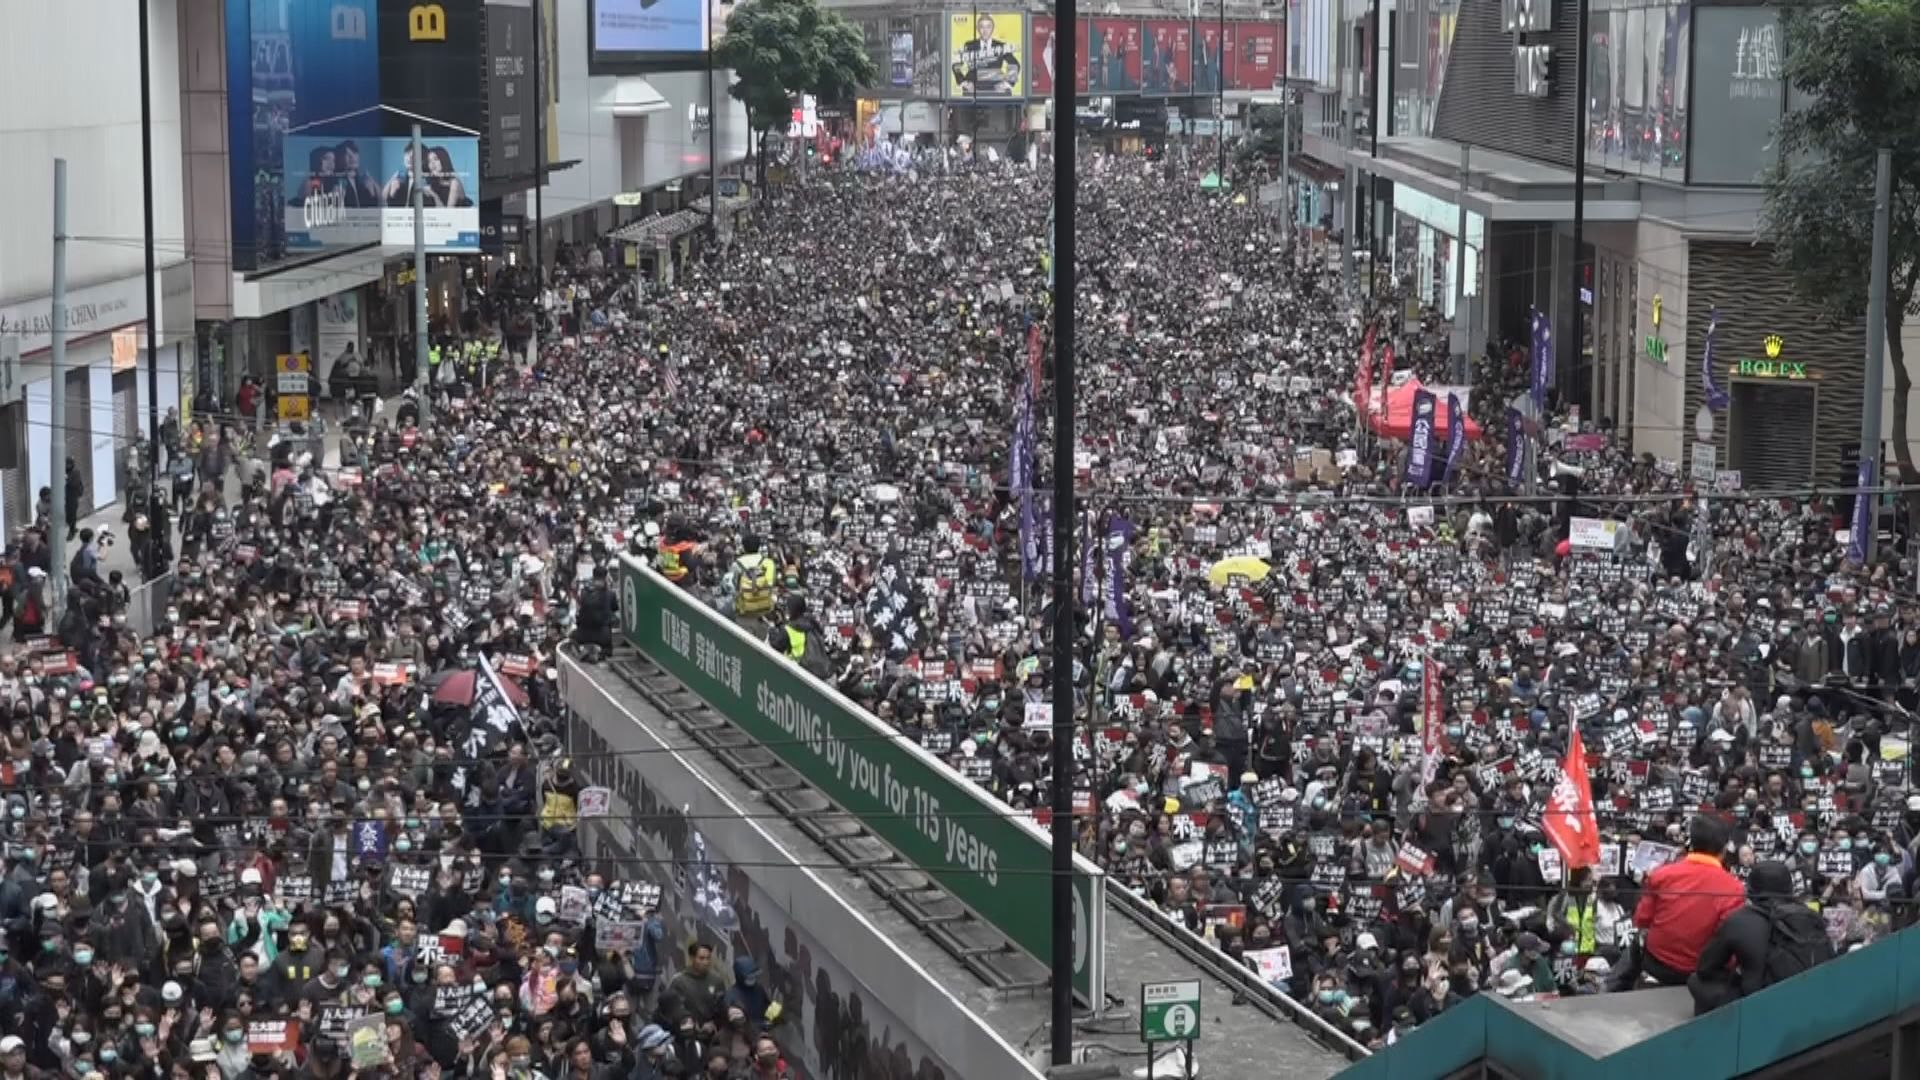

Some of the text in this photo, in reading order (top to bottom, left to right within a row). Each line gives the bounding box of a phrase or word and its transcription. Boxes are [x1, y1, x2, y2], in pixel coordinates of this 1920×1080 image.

[71, 303, 98, 326] CHINA
[1740, 359, 1806, 376] ROLEX
[757, 681, 997, 888] stanDING by you for 115 years
